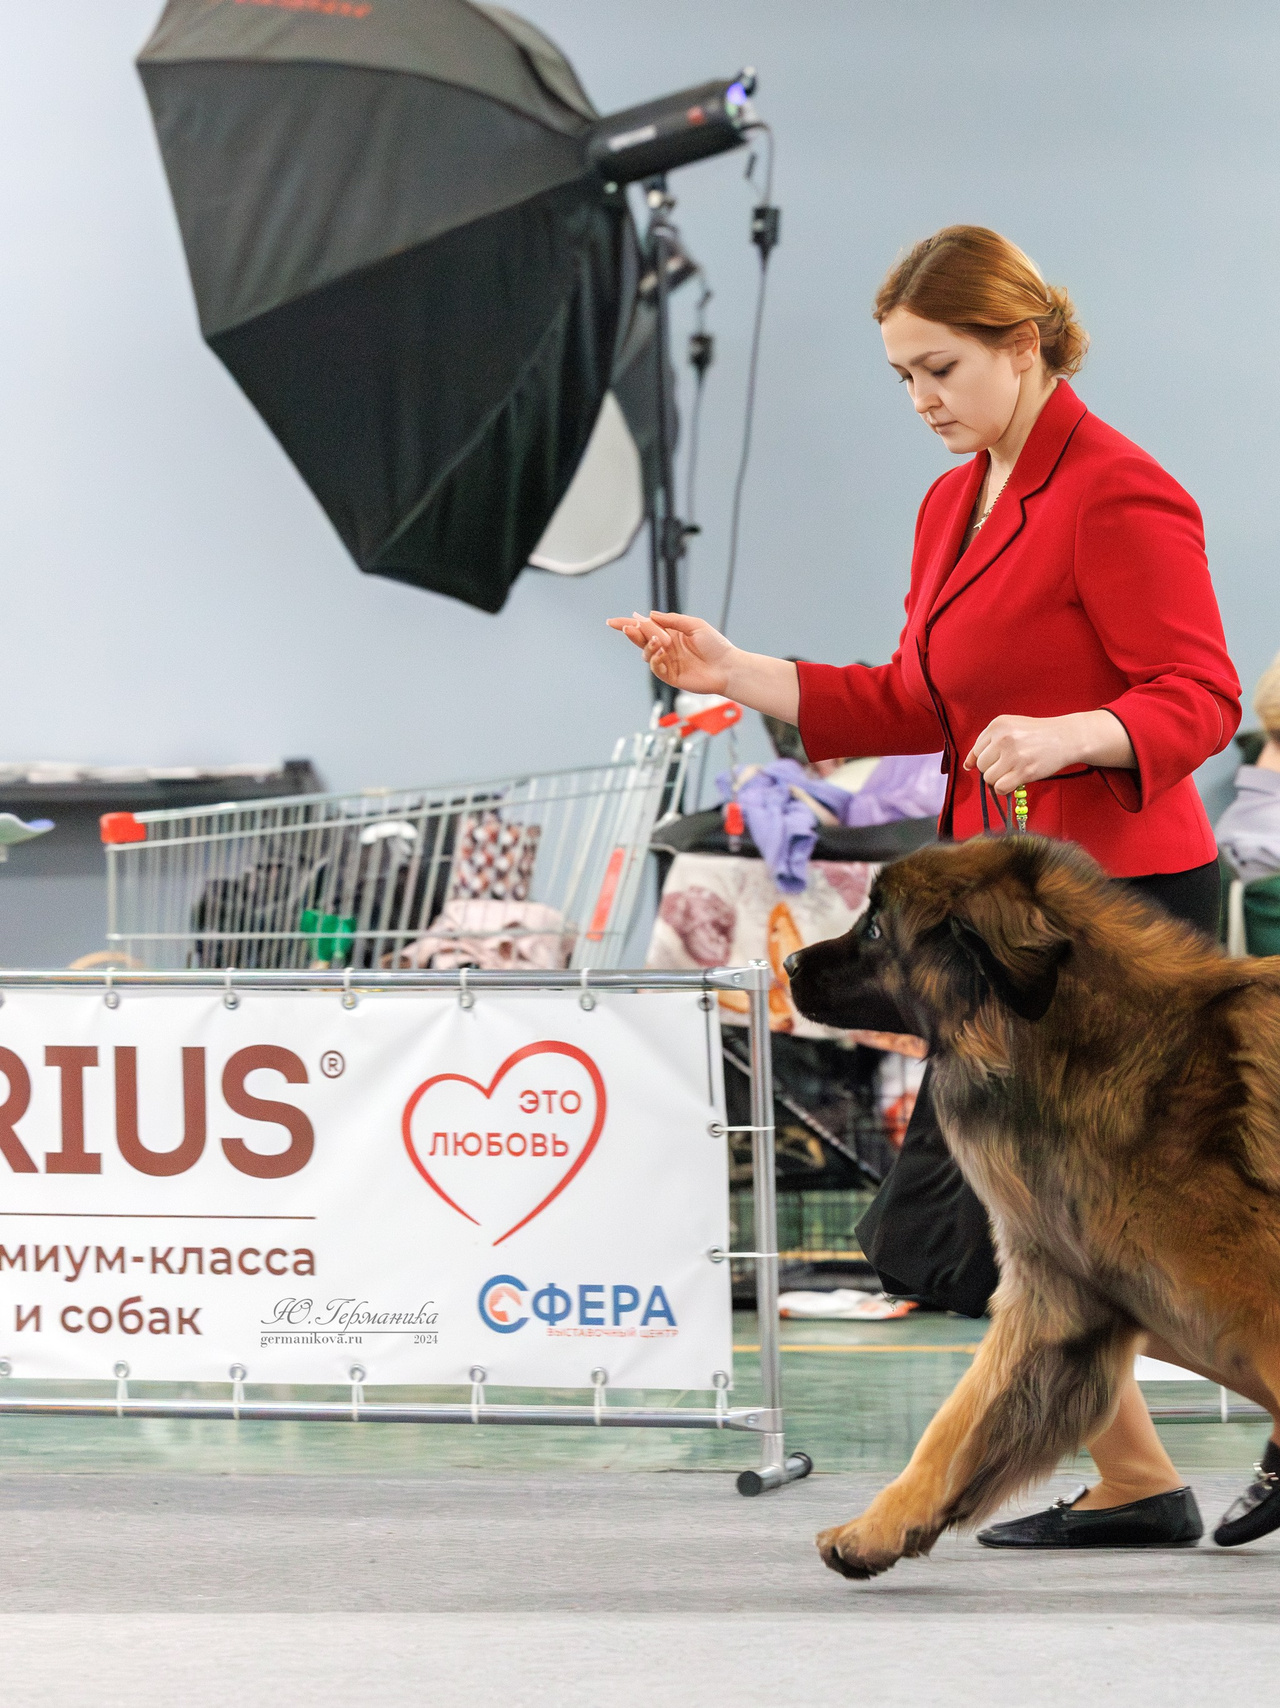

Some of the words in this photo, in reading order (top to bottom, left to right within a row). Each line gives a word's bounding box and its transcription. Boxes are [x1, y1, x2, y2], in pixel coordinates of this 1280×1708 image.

[519, 1089, 582, 1115] ЭТО
[428, 1131, 569, 1158] ЛЮБОВЬ
[14, 1304, 42, 1333] и
[60, 1295, 203, 1336] собак
[477, 1273, 678, 1335] СФЕРА
